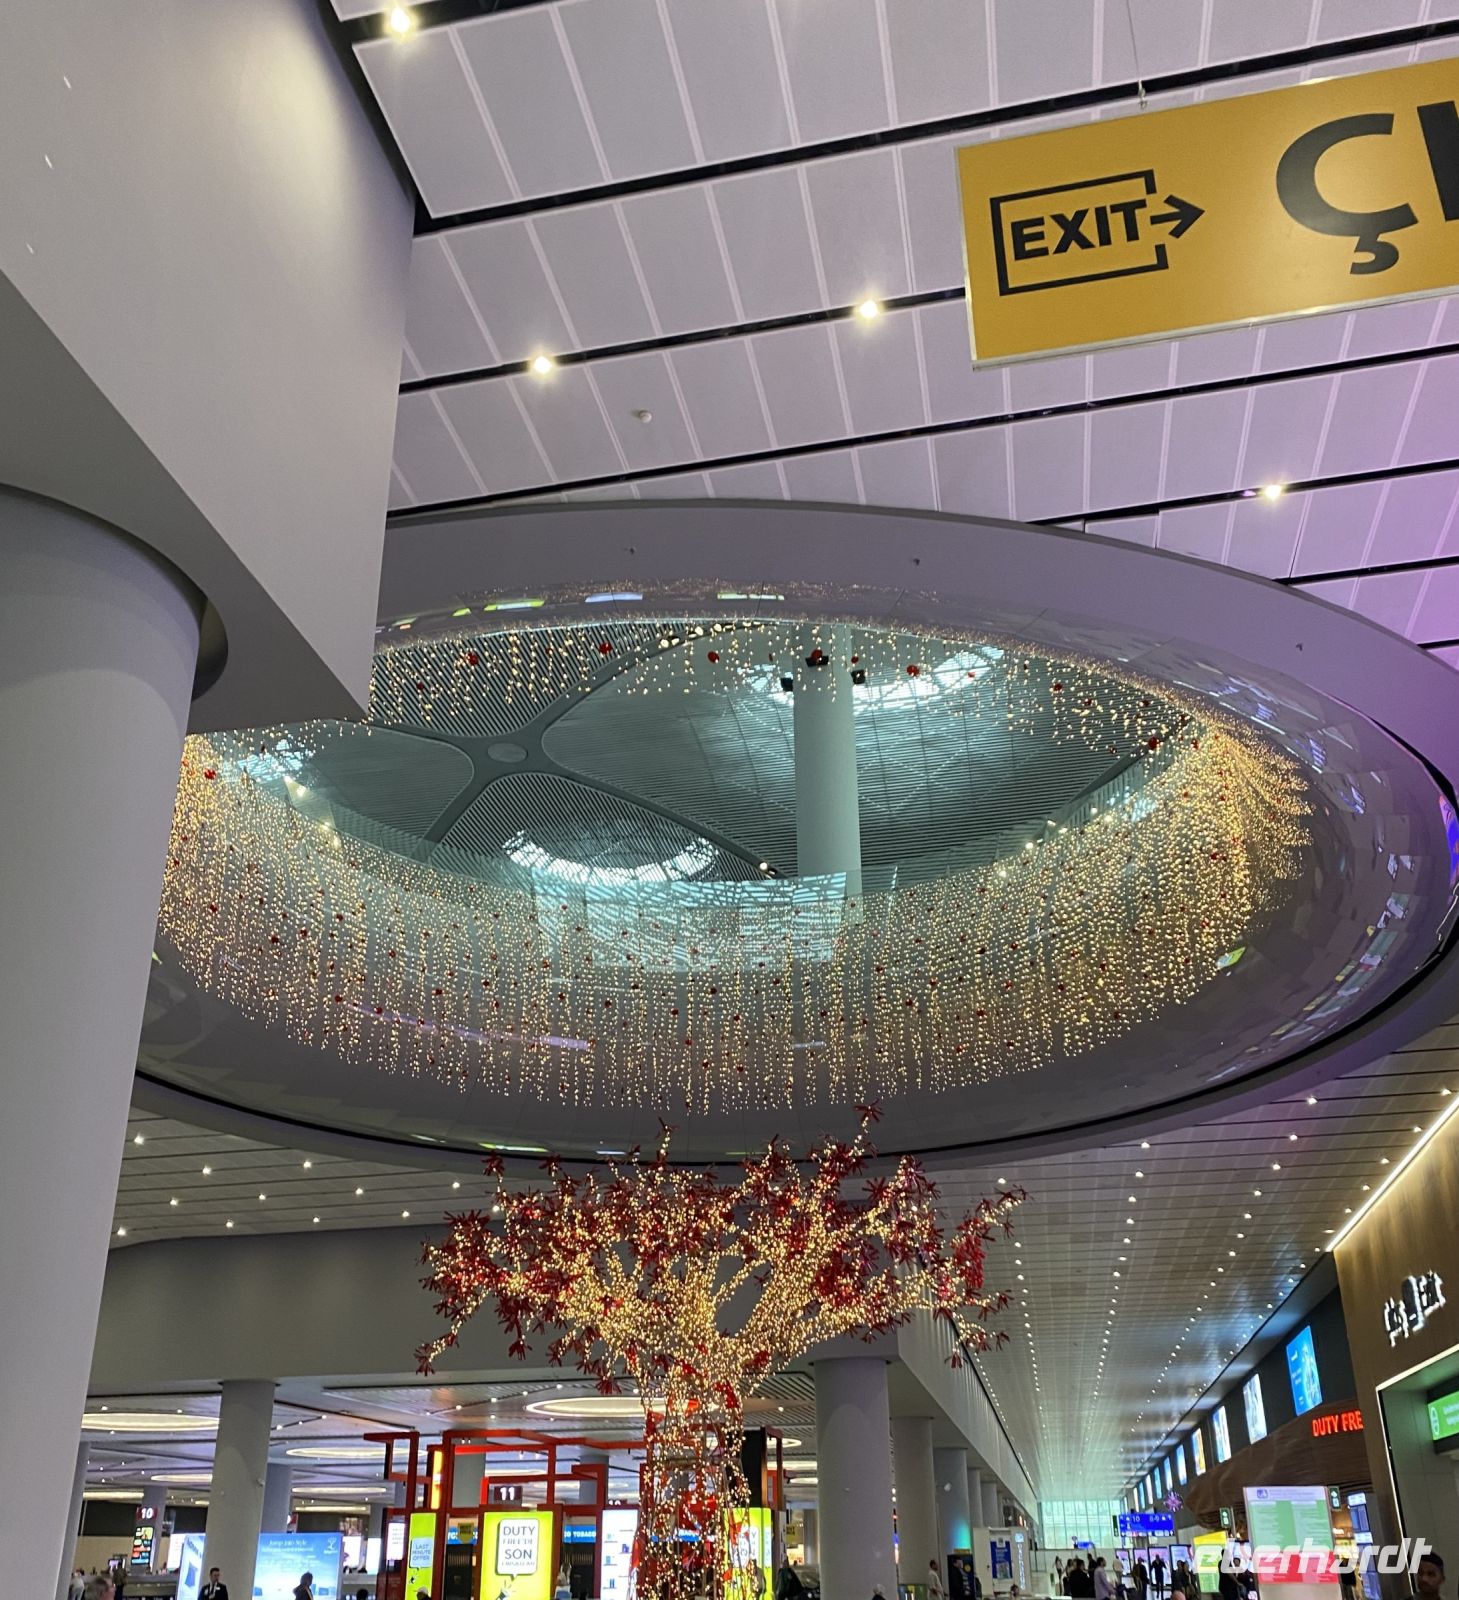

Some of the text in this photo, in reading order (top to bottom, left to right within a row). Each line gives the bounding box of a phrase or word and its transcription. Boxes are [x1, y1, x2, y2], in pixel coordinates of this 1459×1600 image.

[1010, 198, 1147, 262] EXIT
[1312, 1410, 1364, 1437] DUTY FRE
[500, 1486, 515, 1501] 11
[141, 1507, 154, 1519] 10
[503, 1526, 536, 1536] DUTY
[504, 1548, 532, 1560] SON
